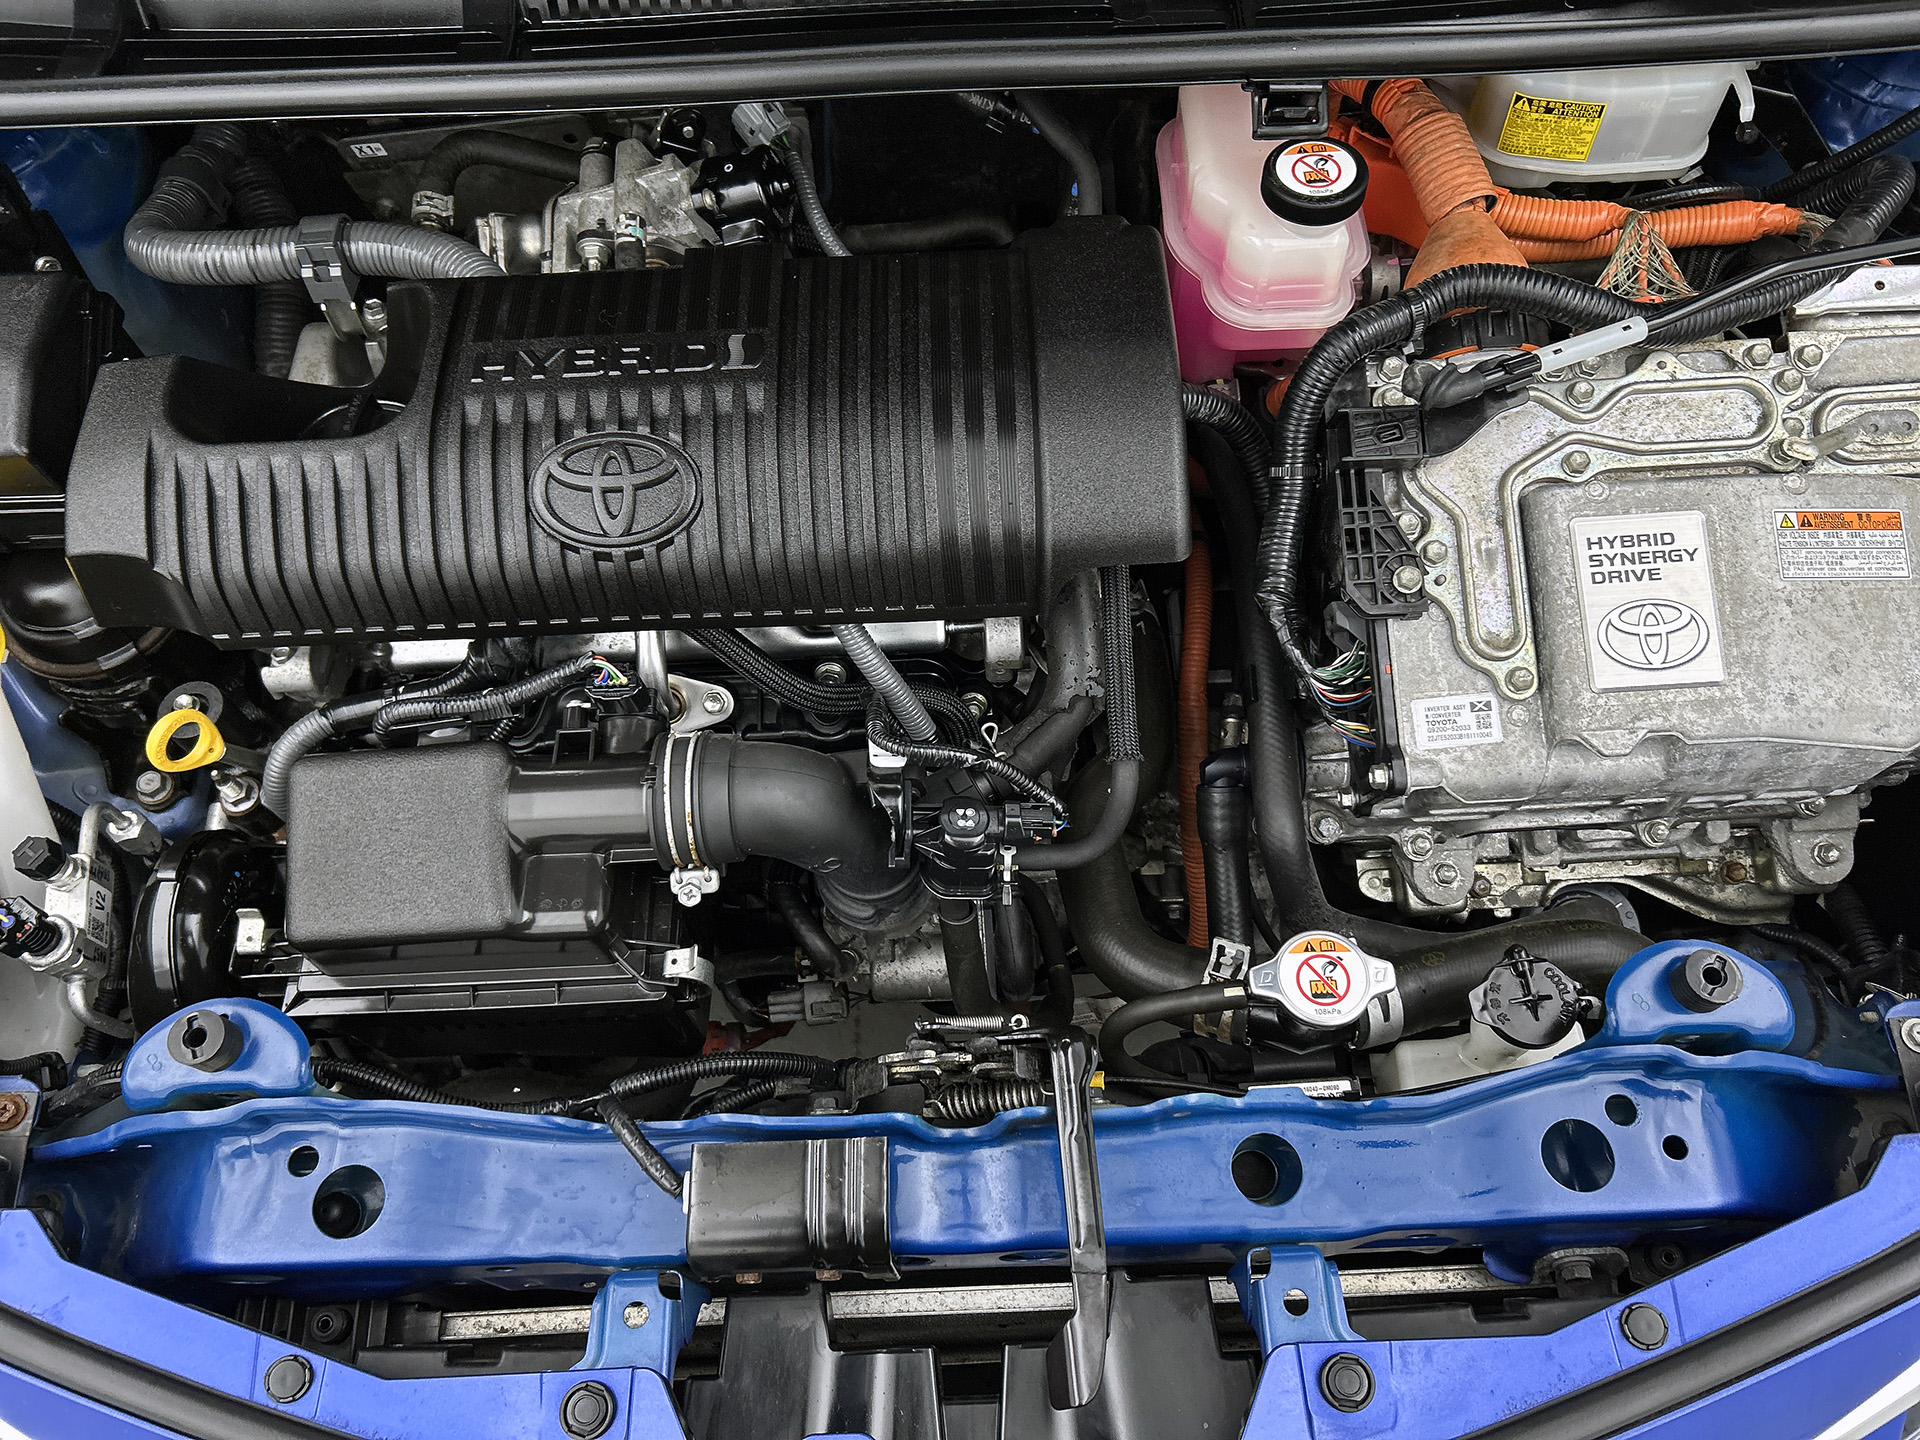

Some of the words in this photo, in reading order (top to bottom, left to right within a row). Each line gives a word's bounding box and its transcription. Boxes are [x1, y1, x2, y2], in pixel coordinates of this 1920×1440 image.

[1564, 102, 1602, 112] CAUTION
[1552, 108, 1600, 118] ATTENTION
[1812, 512, 1845, 521] WARNING
[1586, 532, 1676, 551] HYBRID
[1588, 547, 1699, 568] SYNERGY
[1591, 567, 1663, 585] DRIVE
[1425, 718, 1459, 727] TOYOTA
[95, 890, 107, 911] V2
[1314, 1007, 1342, 1016] 108kPa
